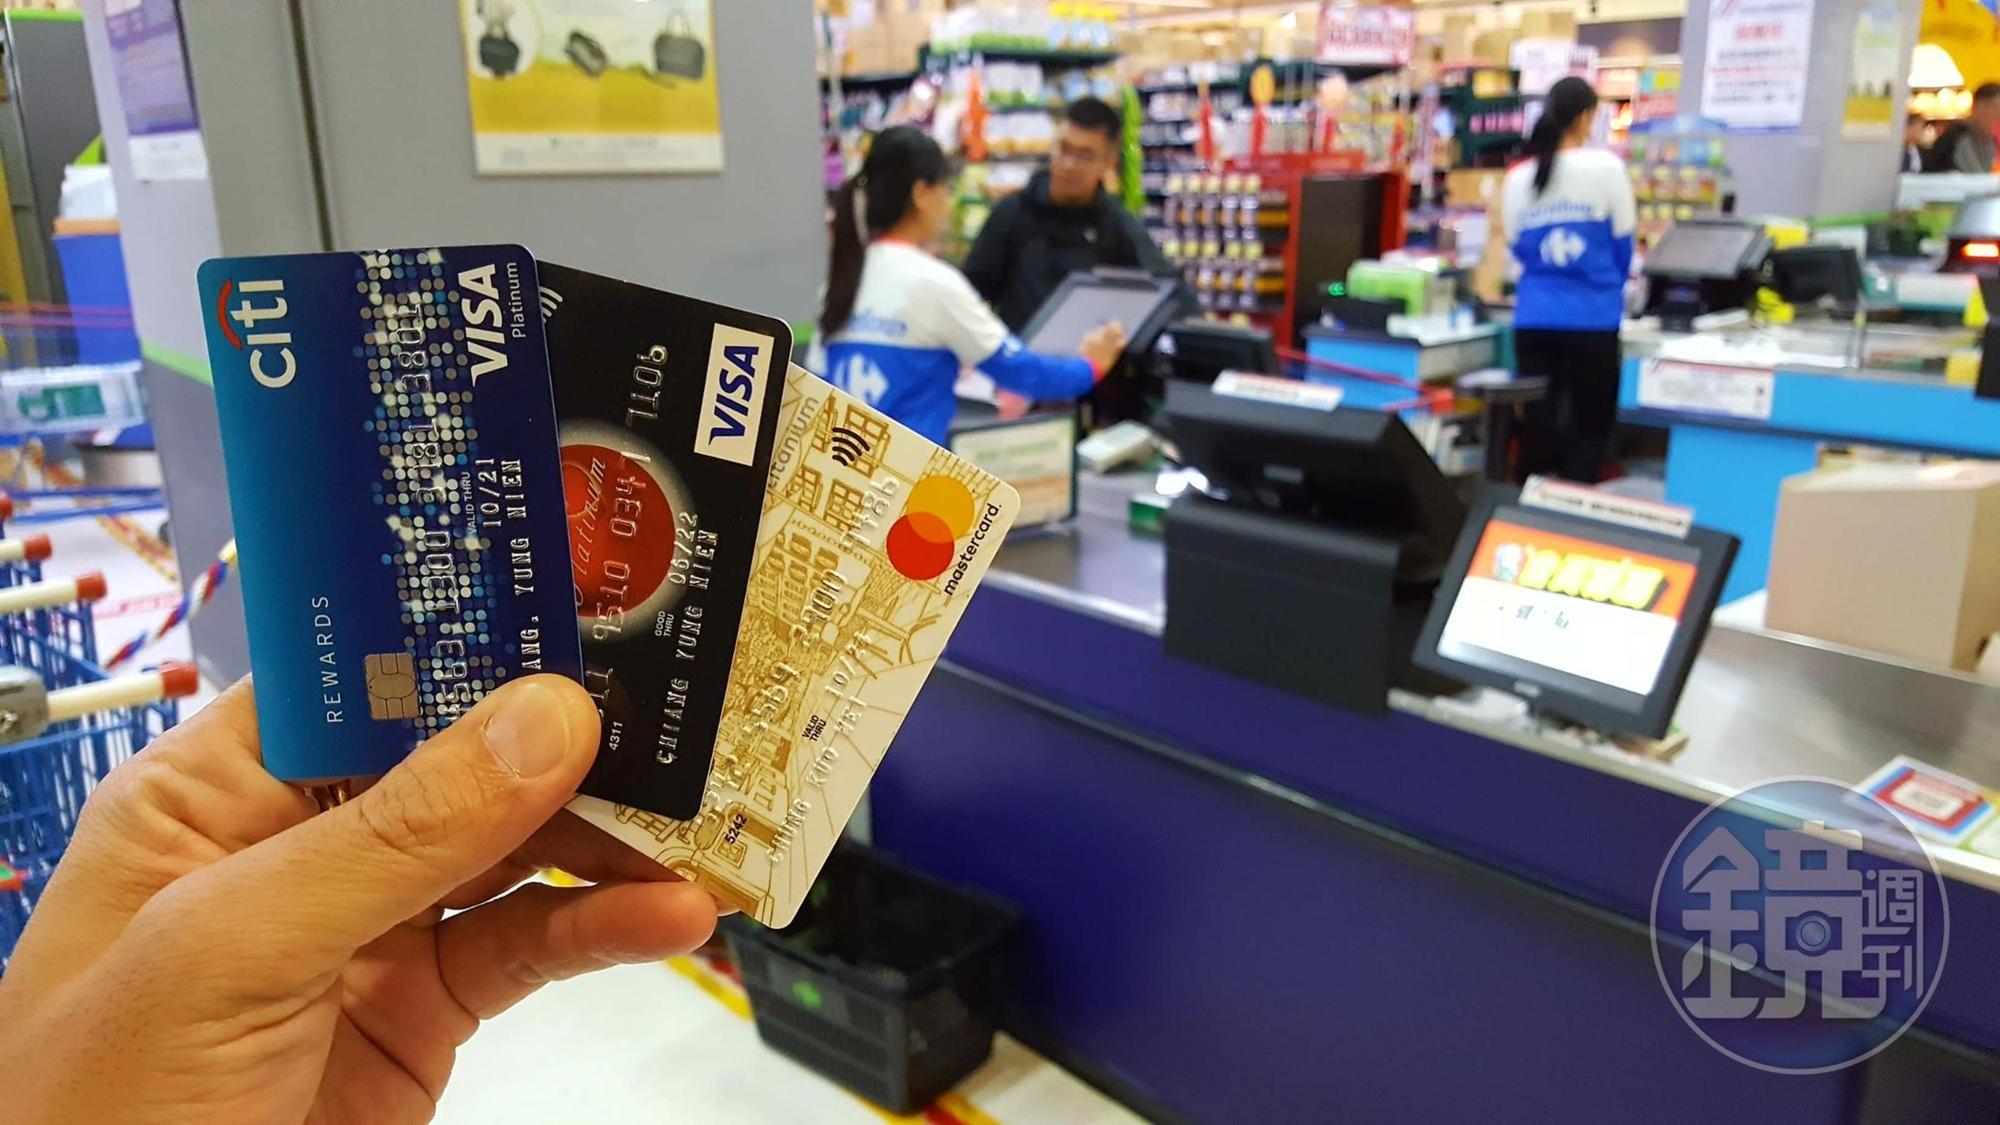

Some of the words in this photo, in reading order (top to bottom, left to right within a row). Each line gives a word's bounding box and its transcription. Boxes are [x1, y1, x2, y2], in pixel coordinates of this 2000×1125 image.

[457, 263, 509, 388] VISA
[504, 262, 527, 339] Platinum
[708, 346, 760, 446] VISA
[463, 471, 473, 502] THRU
[475, 458, 502, 529] 10/21
[501, 459, 527, 519] NIEN
[464, 504, 478, 537] VALID
[575, 458, 607, 606] latinum
[668, 512, 699, 585] 06/22
[510, 537, 534, 596] YUNG
[688, 529, 719, 591] NIEN
[654, 610, 666, 637] GOOD
[663, 613, 675, 638] THRU
[675, 605, 704, 661] YUNG
[312, 596, 344, 724] REWARDS
[608, 721, 623, 751] 4311
[655, 678, 690, 765] CHIANG
[801, 713, 820, 739] VALID
[808, 719, 827, 743] THRU
[724, 813, 748, 845] 5242
